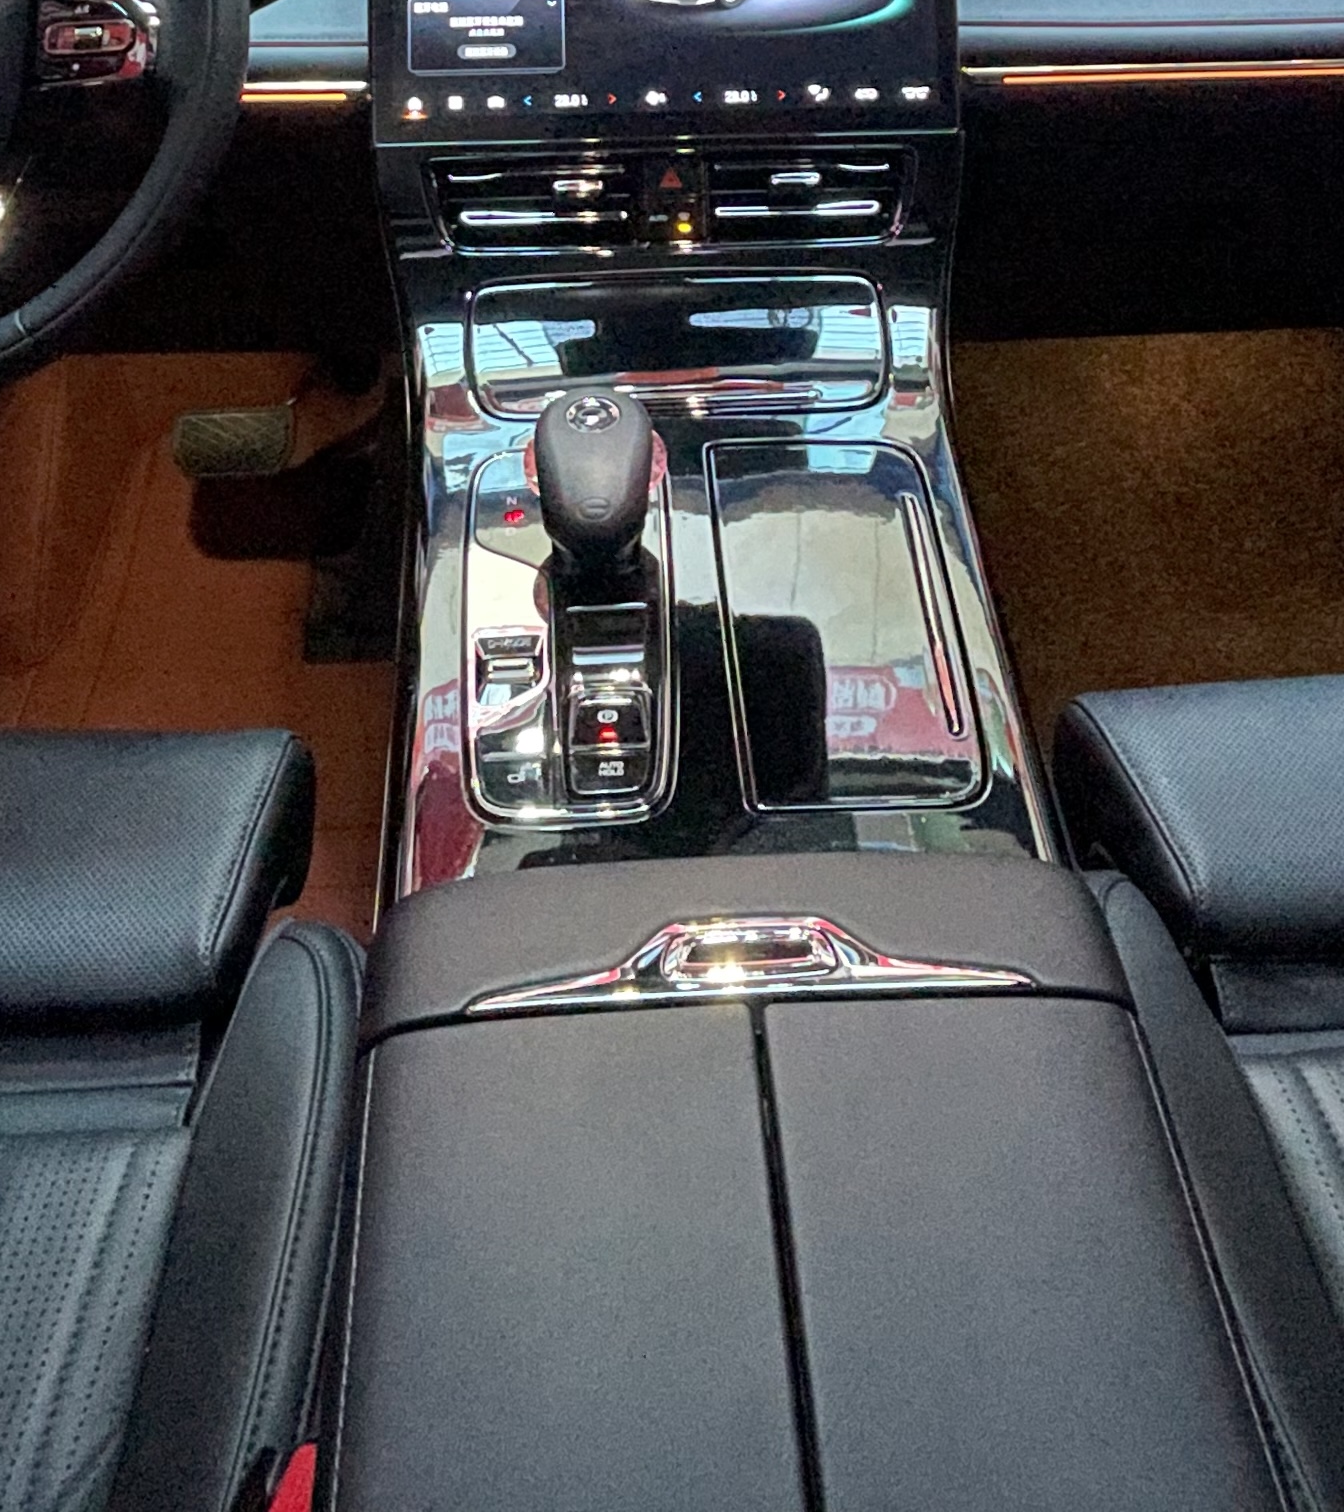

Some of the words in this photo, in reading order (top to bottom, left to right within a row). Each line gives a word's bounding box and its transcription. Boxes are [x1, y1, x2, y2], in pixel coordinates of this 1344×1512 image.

[506, 497, 518, 506] N
[598, 761, 624, 770] AUTO
[598, 767, 625, 777] HOLD
